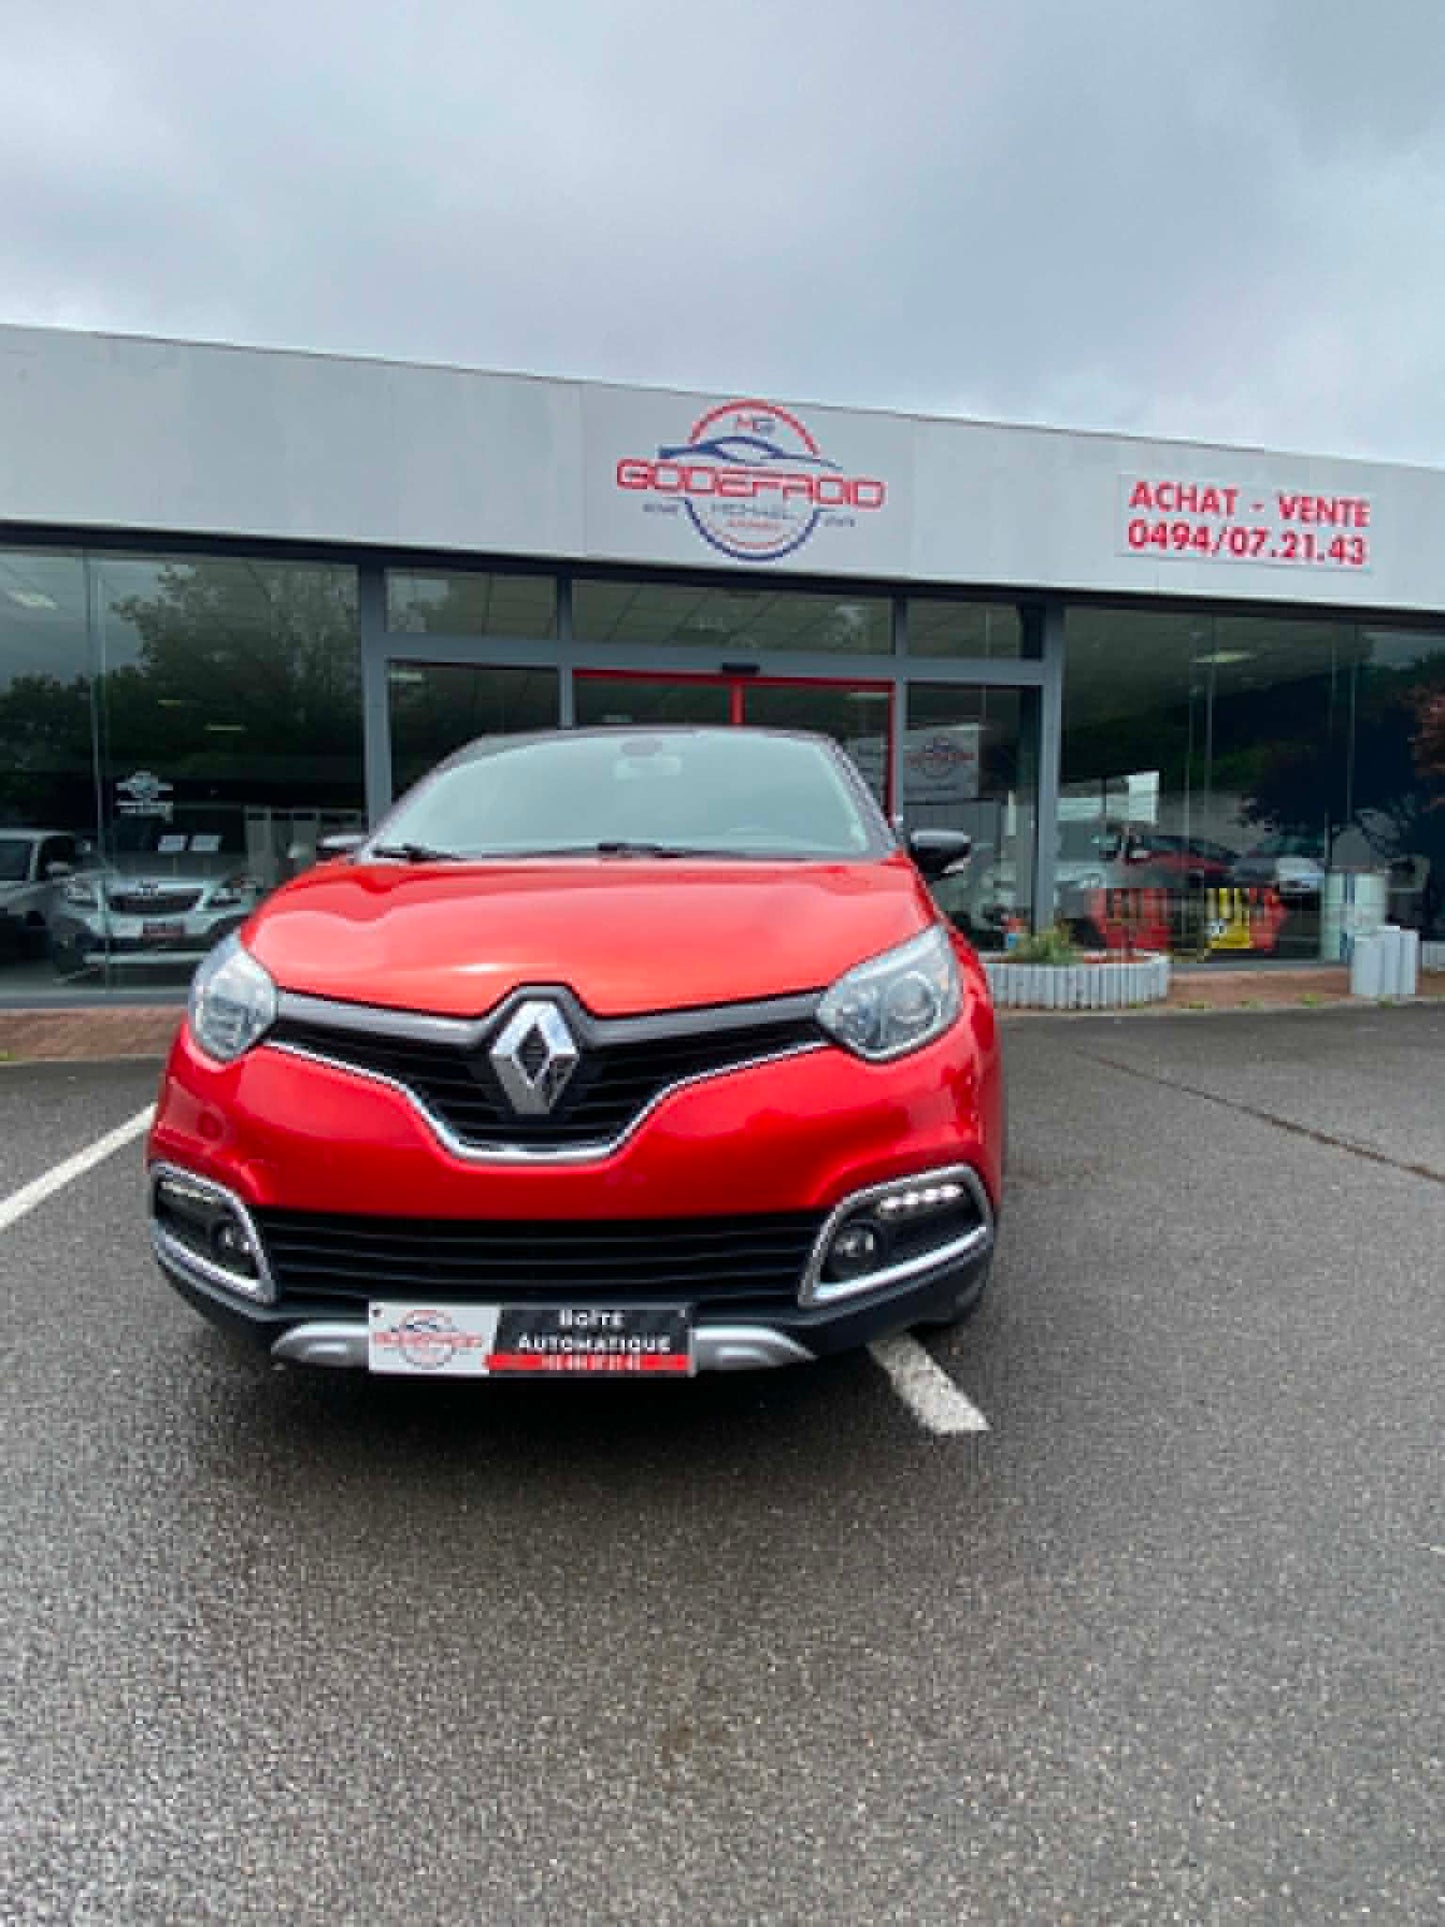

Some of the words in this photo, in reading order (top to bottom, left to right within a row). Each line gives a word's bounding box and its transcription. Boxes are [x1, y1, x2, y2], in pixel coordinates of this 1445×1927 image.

[617, 458, 887, 510] GODEFROID
[1129, 481, 1238, 515] ACHAT
[1279, 495, 1371, 528] VENTE
[1129, 518, 1367, 565] 0494/07.21.43
[518, 1332, 671, 1354] AUTOMATIQUE
